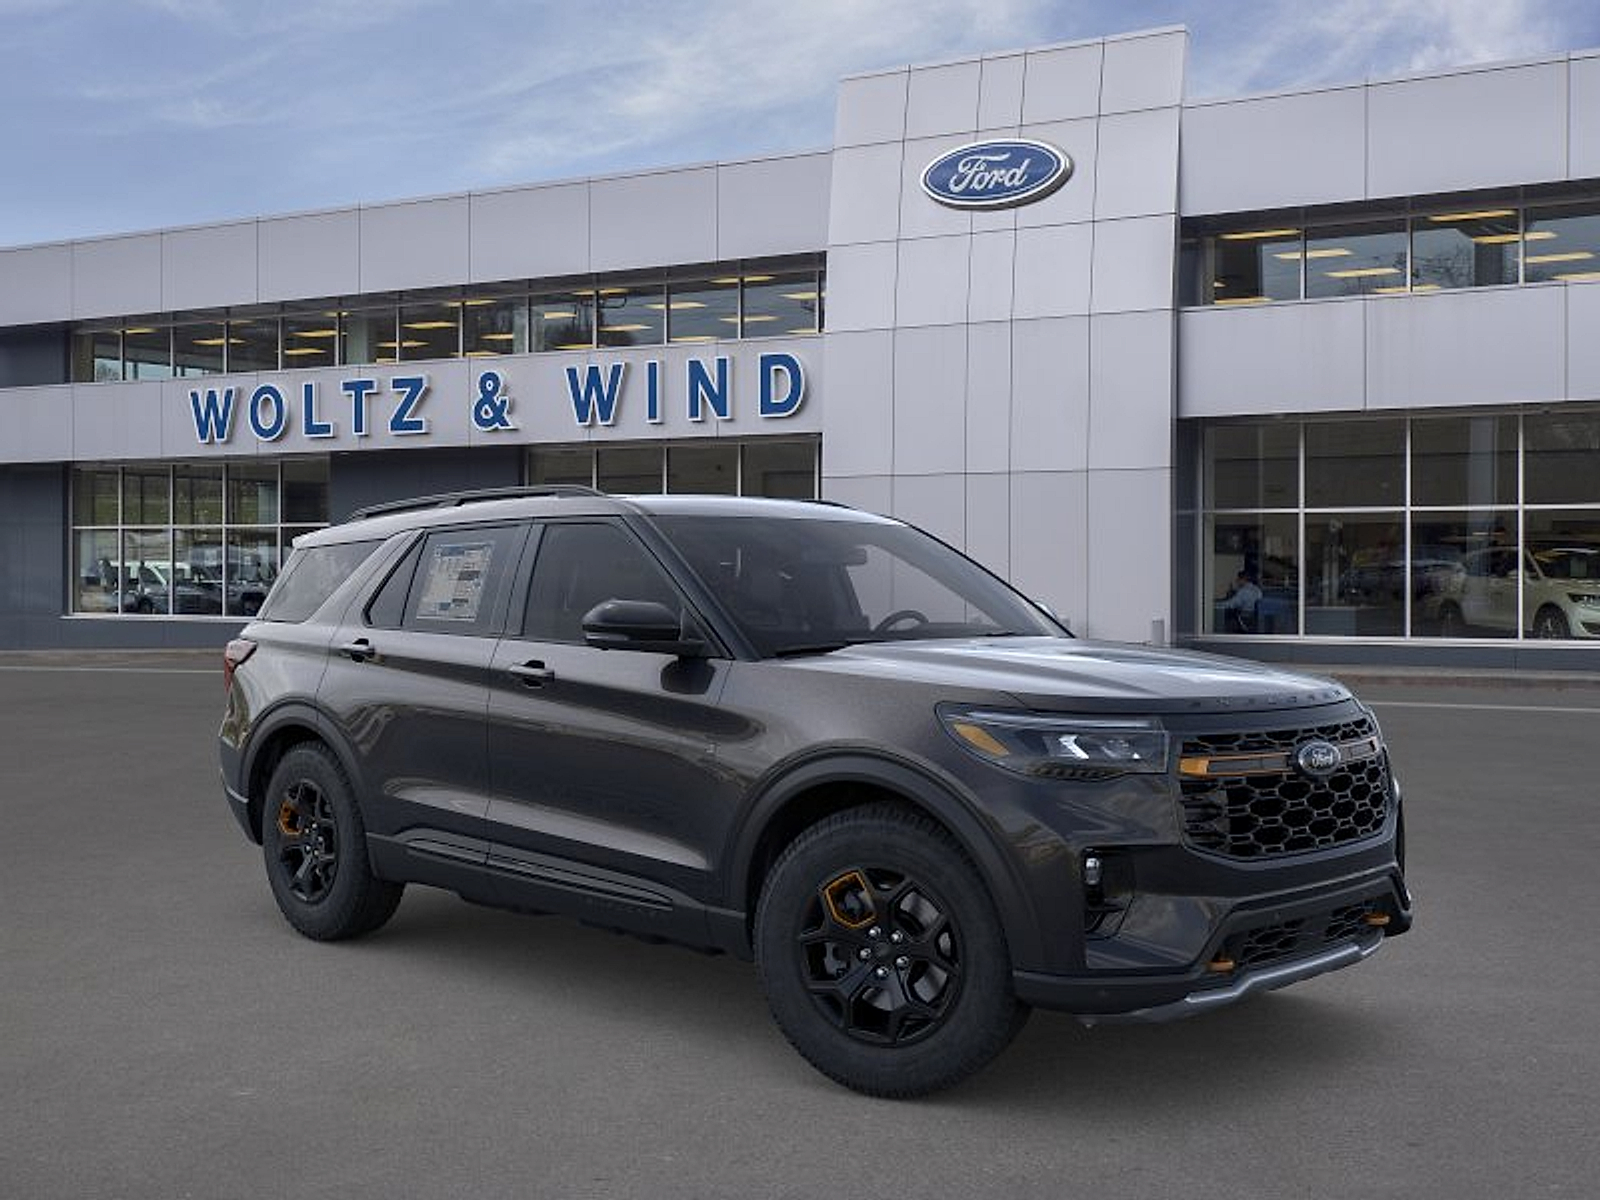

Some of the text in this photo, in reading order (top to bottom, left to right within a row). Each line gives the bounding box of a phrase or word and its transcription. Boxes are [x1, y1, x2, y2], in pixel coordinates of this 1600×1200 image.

[949, 152, 1031, 193] Ford
[189, 353, 804, 443] WOLTZ & WIND
[1311, 748, 1333, 768] Ford
